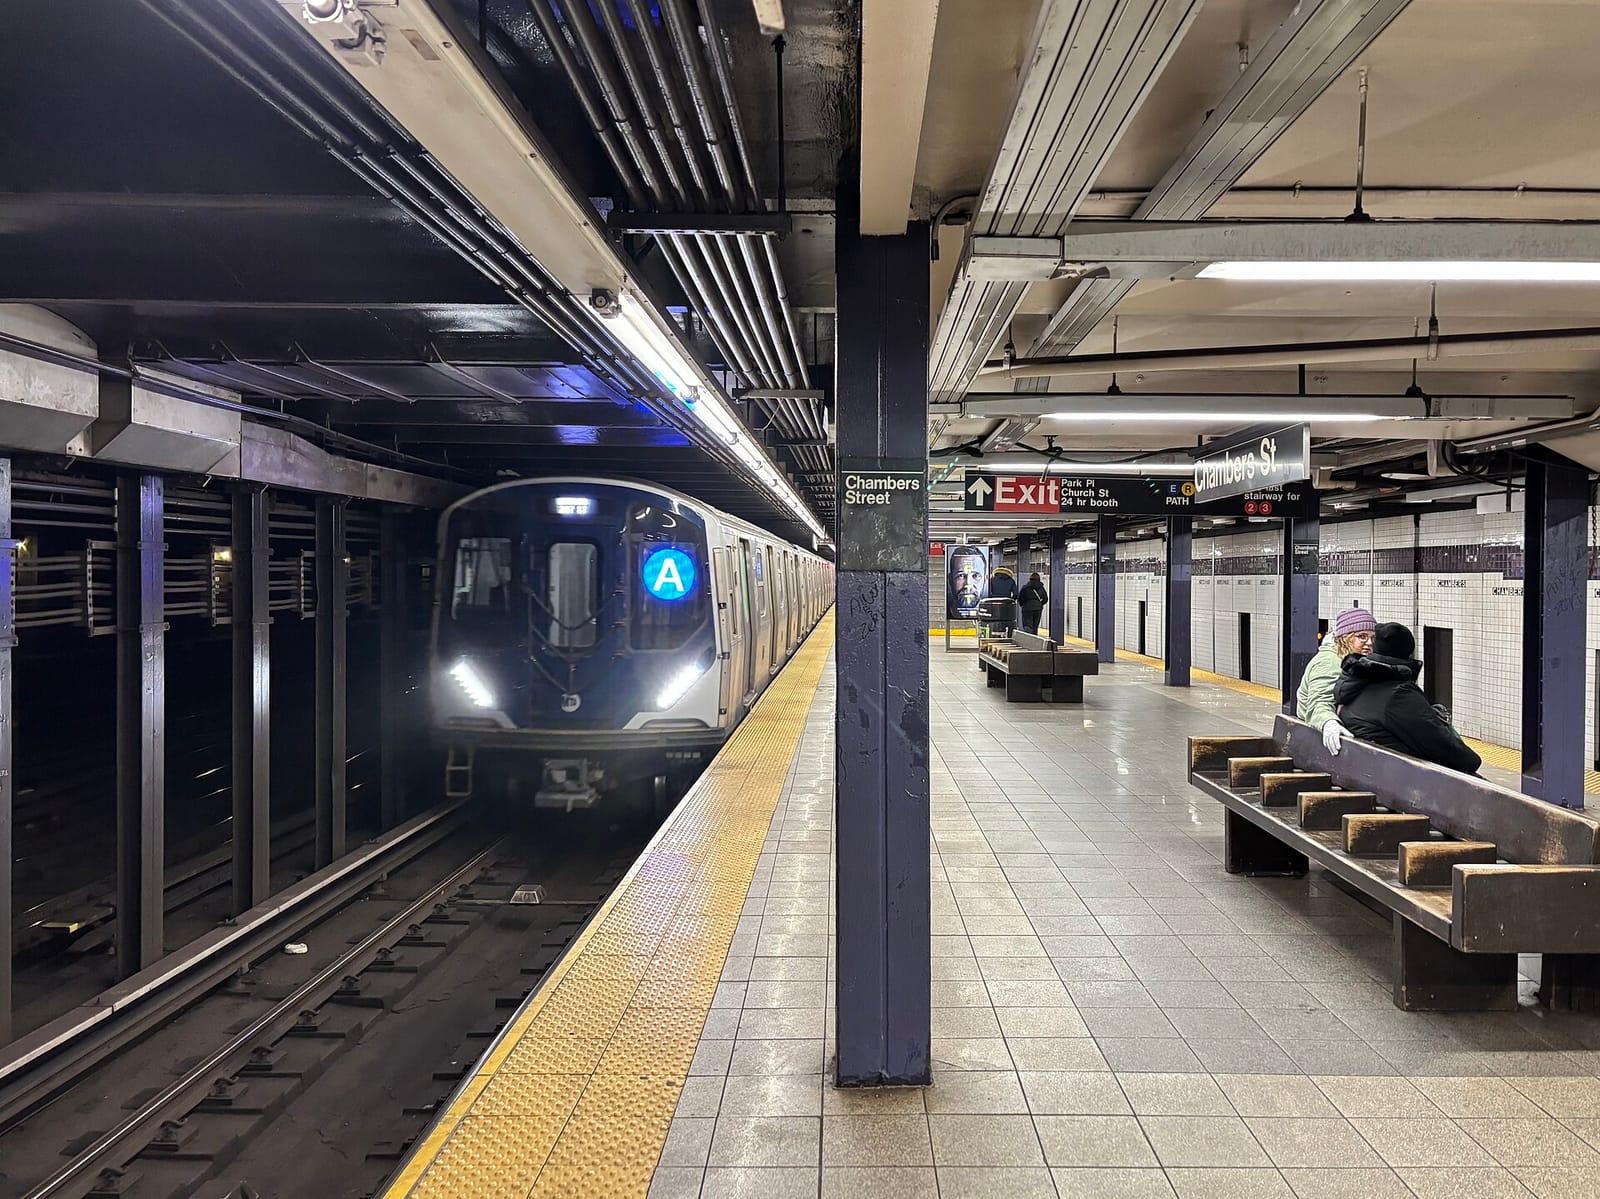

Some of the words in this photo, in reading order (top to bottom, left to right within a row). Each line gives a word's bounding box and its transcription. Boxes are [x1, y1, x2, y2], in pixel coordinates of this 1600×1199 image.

[1194, 451, 1255, 493] Chambers
[1260, 437, 1277, 476] St
[845, 475, 920, 490] Chambers
[1061, 479, 1082, 487] Park
[1086, 479, 1095, 487] Pl
[995, 477, 1059, 505] Exit
[1061, 488, 1095, 497] Church
[1098, 489, 1109, 498] St
[1244, 491, 1283, 502] stairway
[1287, 492, 1300, 500] for
[845, 490, 890, 504] Street
[1061, 498, 1073, 506] 24
[1077, 498, 1086, 506] hr
[1090, 498, 1118, 507] booth
[1166, 497, 1189, 505] PATH
[653, 558, 685, 592] A
[1491, 586, 1523, 596] CHAMBER
